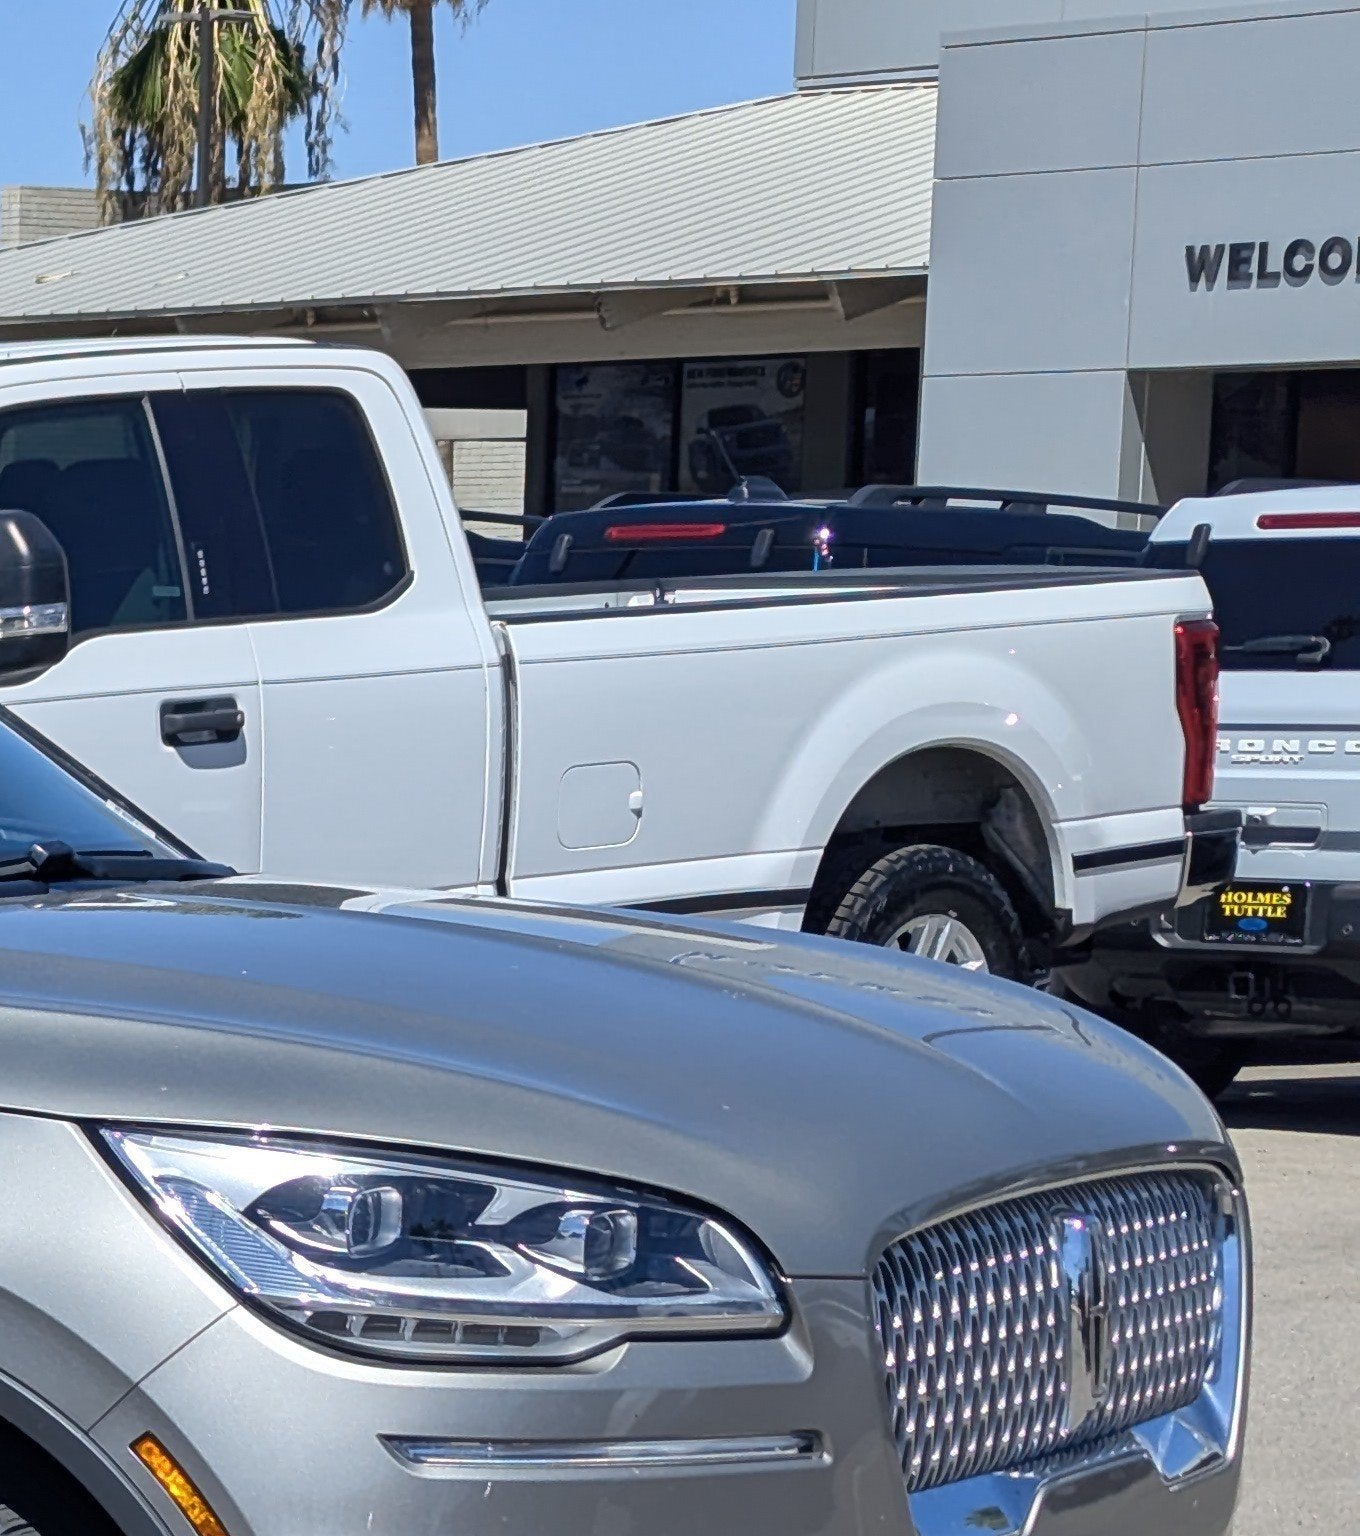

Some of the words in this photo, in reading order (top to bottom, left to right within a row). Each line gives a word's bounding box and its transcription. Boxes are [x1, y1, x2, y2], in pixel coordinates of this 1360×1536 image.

[1185, 236, 1360, 292] WELCO
[1216, 739, 1360, 755] RONCO
[1230, 754, 1305, 765] SPORT
[1219, 891, 1293, 905] HOLMES
[1221, 904, 1288, 918] TUTTLE
